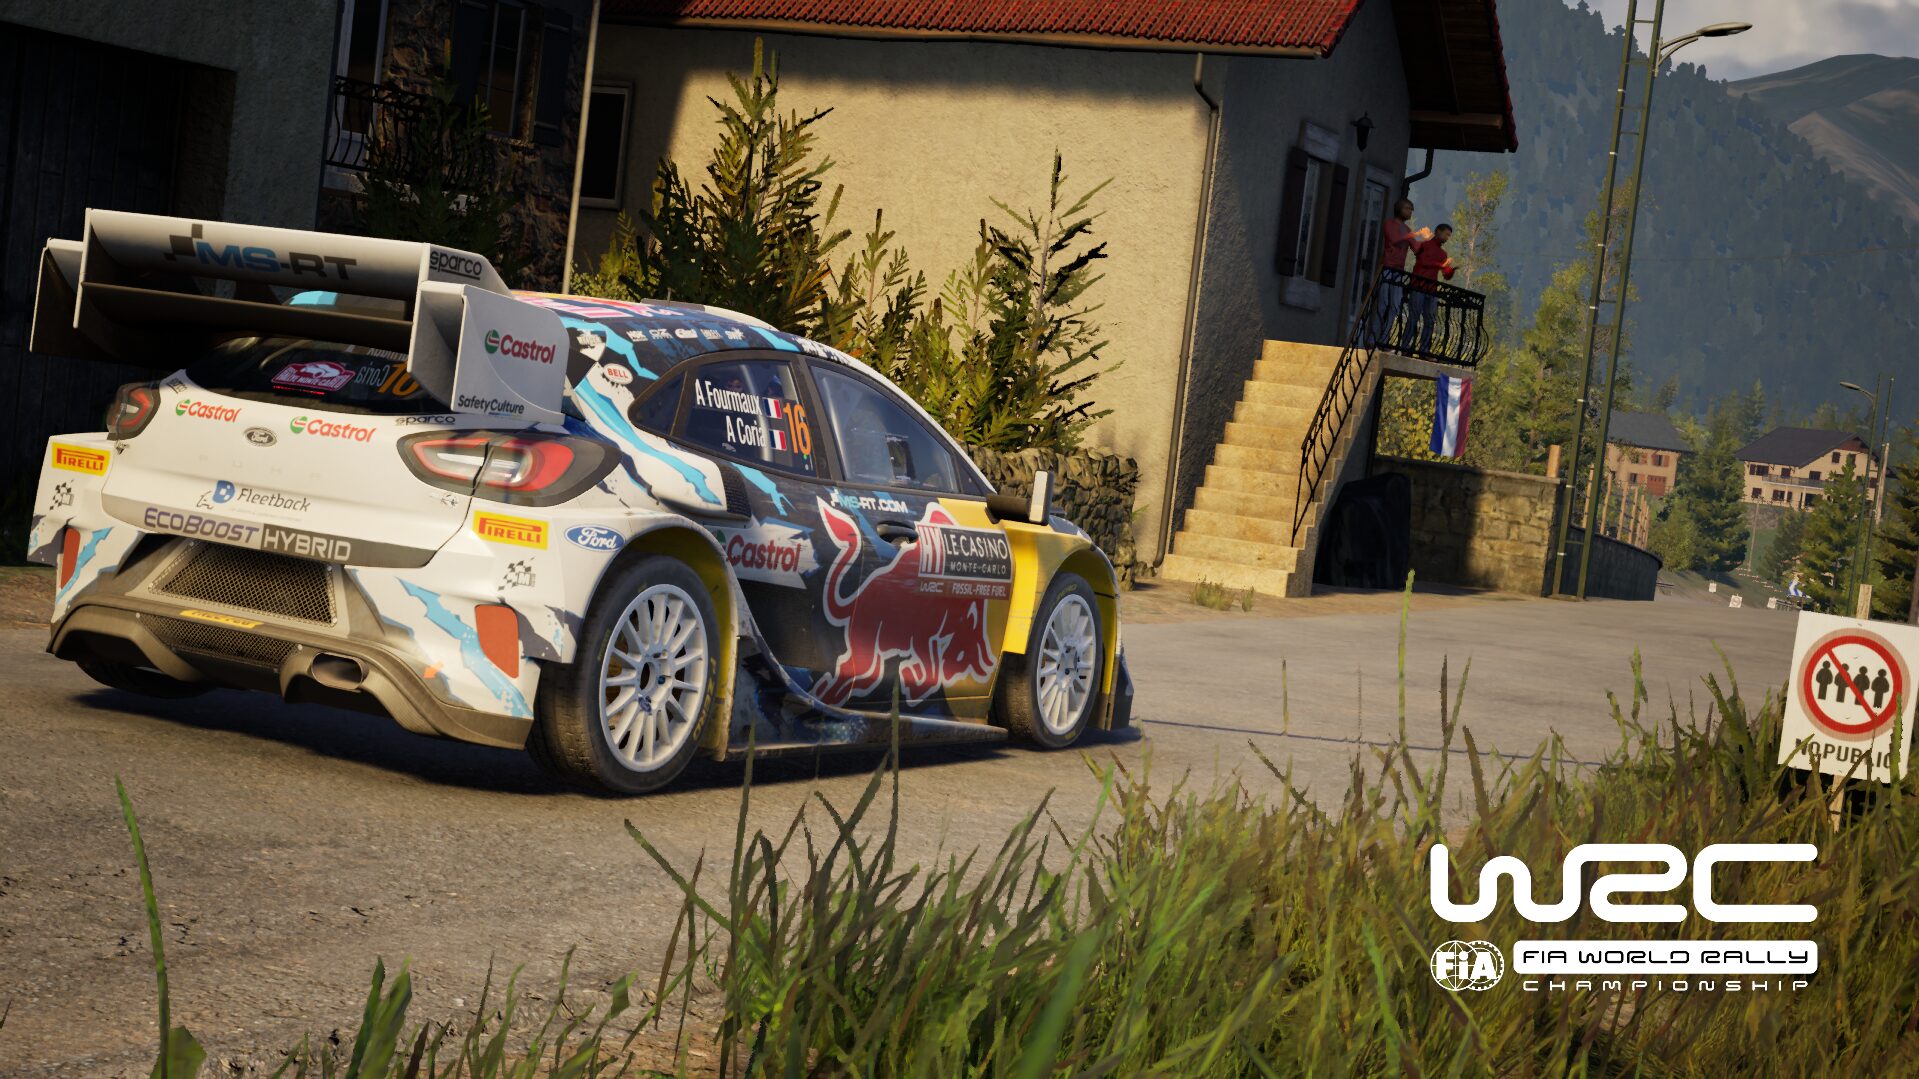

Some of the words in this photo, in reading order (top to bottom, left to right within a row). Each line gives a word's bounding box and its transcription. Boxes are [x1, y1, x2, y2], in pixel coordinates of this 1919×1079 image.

[196, 241, 357, 280] MS-RT
[429, 249, 483, 277] sparco
[500, 334, 556, 364] Castrol
[607, 367, 629, 380] BELL
[188, 401, 242, 423] Castrol
[457, 394, 525, 415] SafetyCulture
[694, 378, 706, 406] A
[705, 380, 763, 416] Fourmaux
[783, 402, 812, 455] 16
[306, 419, 376, 443] Castrol
[395, 414, 456, 426] sparco
[725, 415, 736, 443] A
[736, 417, 767, 448] Coria
[56, 447, 106, 471] PIRELLI
[236, 488, 312, 513] Fleetback
[143, 507, 260, 544] ECOBOOST
[262, 527, 352, 562] HYBRID
[478, 517, 543, 544] PIRELLI
[577, 526, 617, 549] Ford
[727, 533, 802, 573] Castrol
[990, 585, 1008, 597] FUEL
